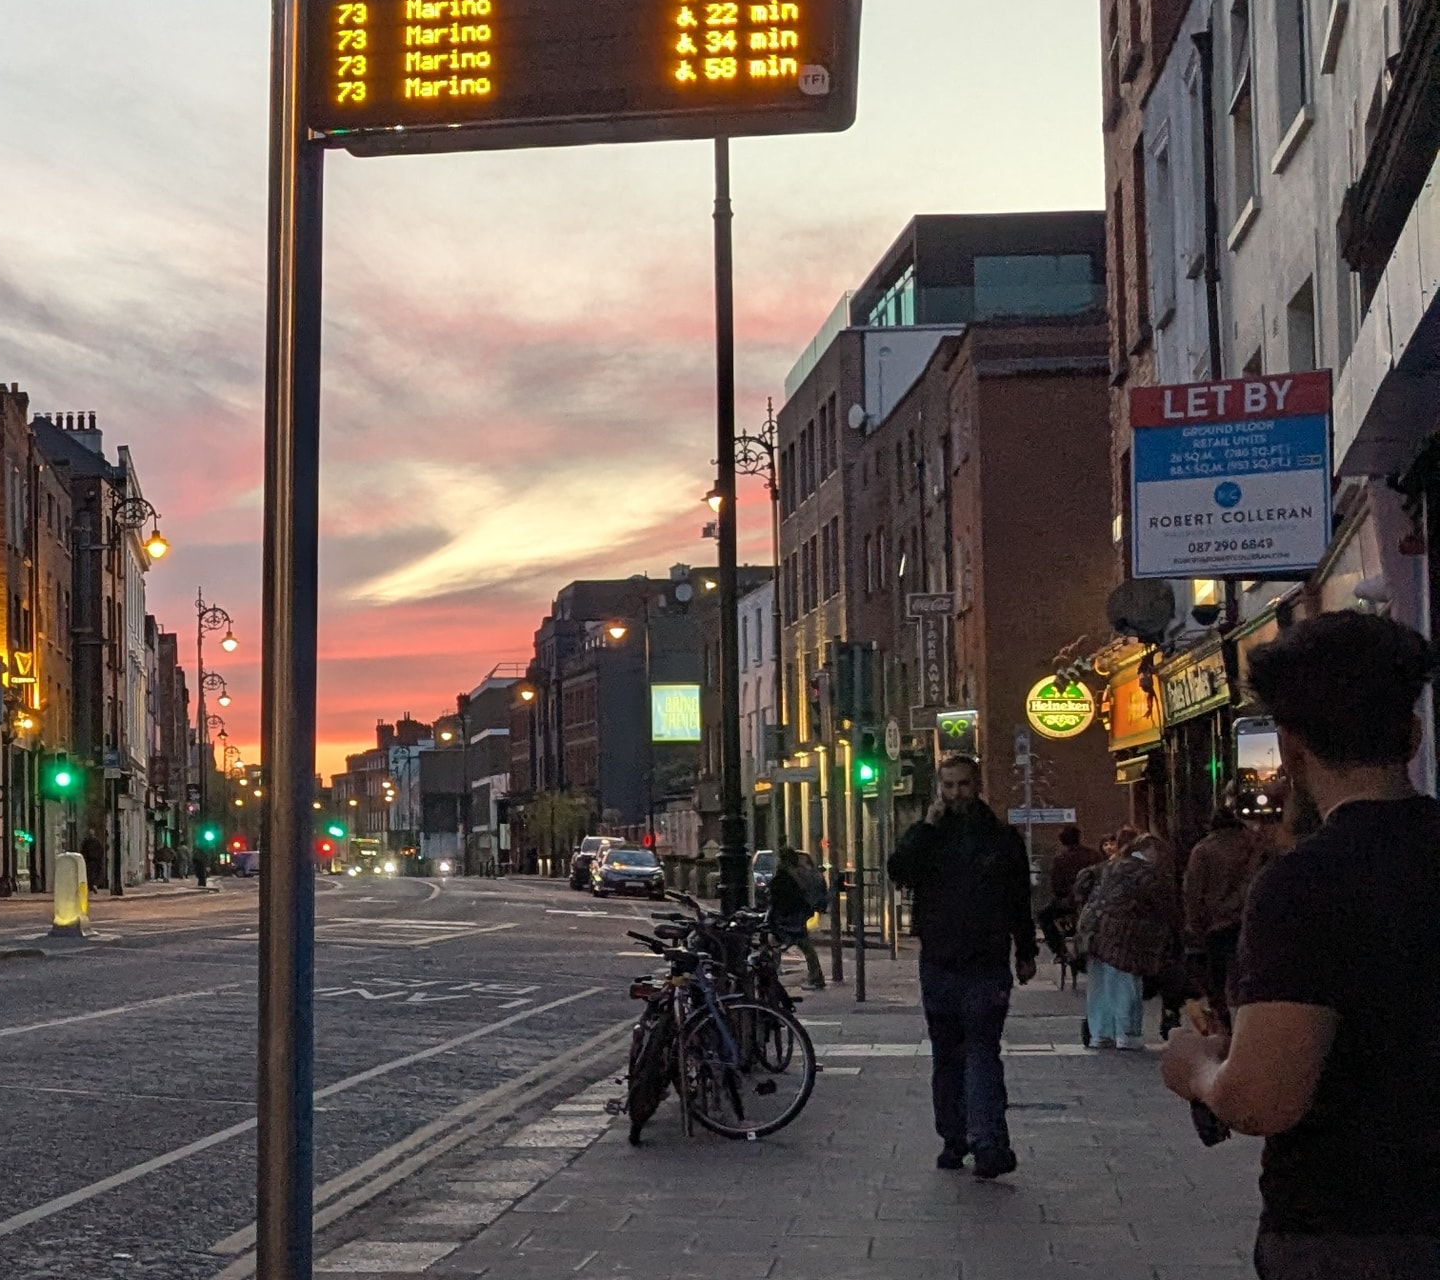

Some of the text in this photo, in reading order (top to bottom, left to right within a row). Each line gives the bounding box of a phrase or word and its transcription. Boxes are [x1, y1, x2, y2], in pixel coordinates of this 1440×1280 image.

[337, 3, 367, 24] 73
[337, 0, 799, 50] 73 Marino 22 min
[337, 27, 799, 76] 73 Marino 34 min
[337, 54, 798, 102] 73 Marino 58 min
[1164, 379, 1293, 419] LET BY
[1182, 421, 1275, 437] GROUND FLOOR
[1193, 434, 1267, 448] RETAIL UNITS
[1149, 506, 1312, 529] ROBERT COLLERAN
[1188, 542, 1211, 553] 087
[927, 620, 940, 701] TAKE AWAY
[1031, 700, 1090, 712] Heineken
